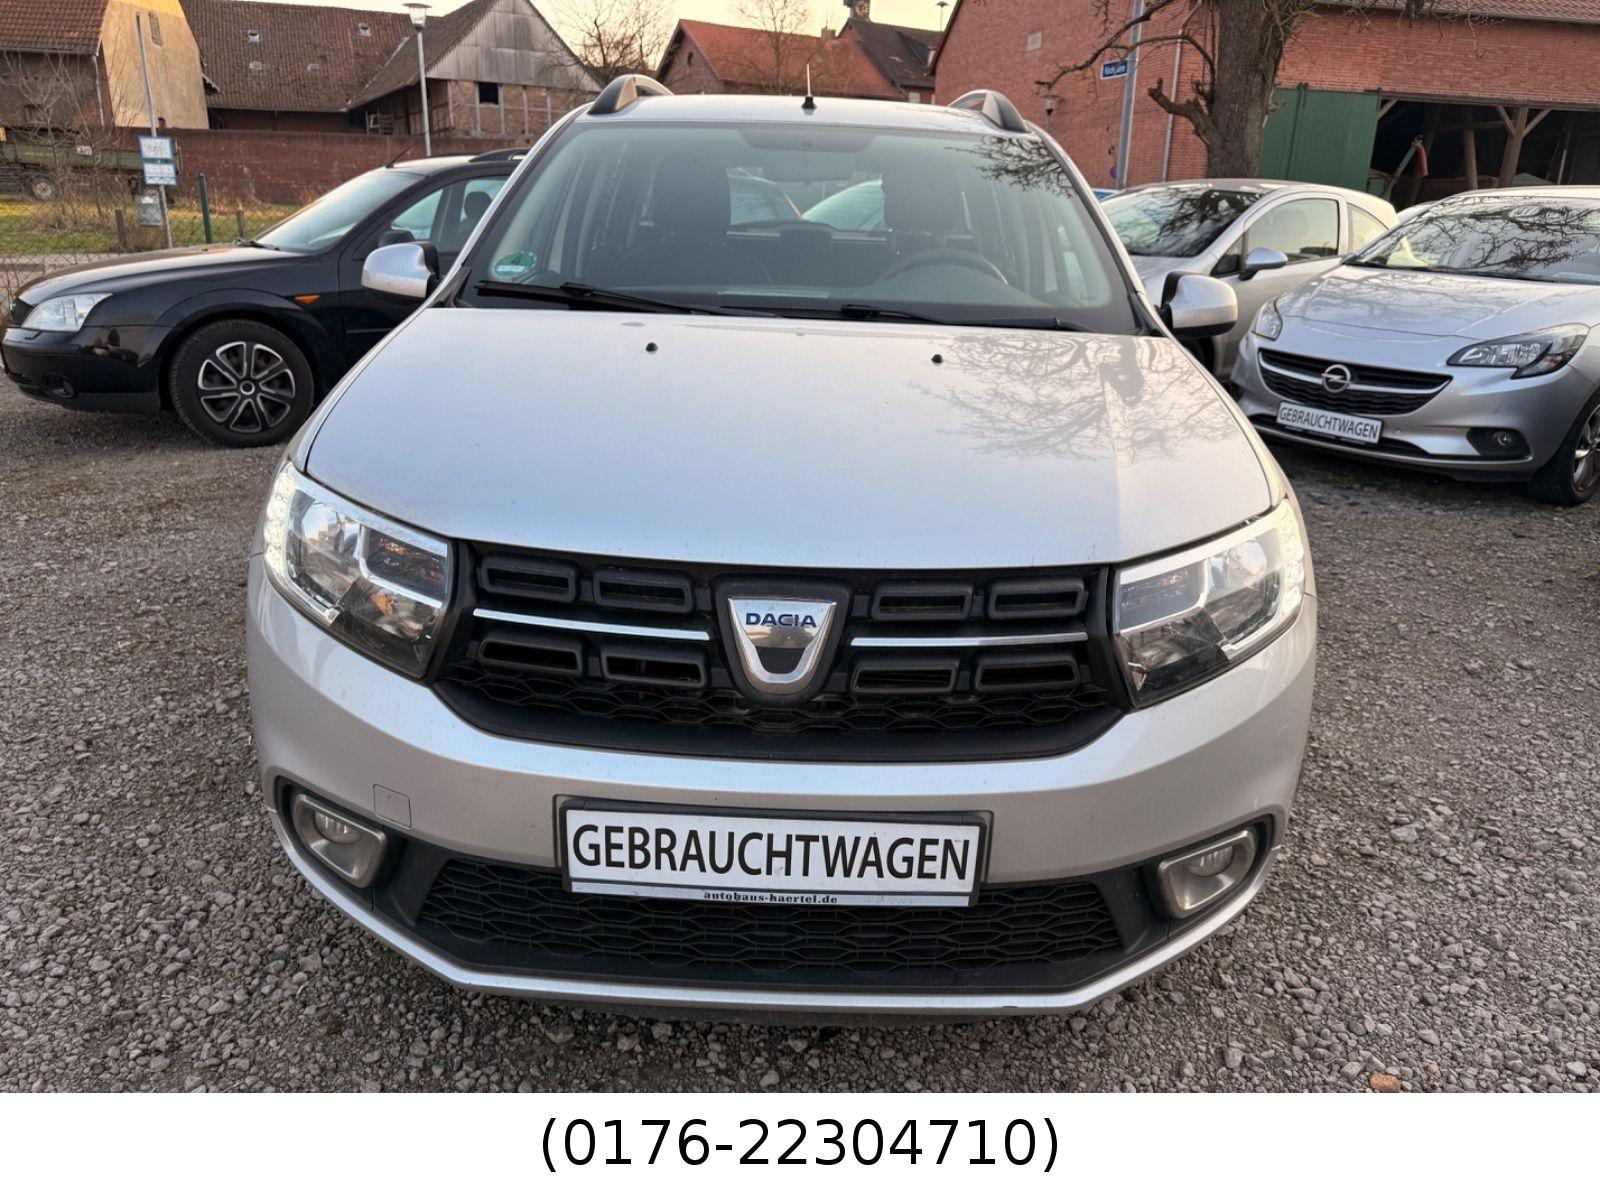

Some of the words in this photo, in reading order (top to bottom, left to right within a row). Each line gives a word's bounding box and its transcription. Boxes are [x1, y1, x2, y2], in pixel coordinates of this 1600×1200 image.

[1280, 407, 1379, 438] GEBRAUCHTWAGEN
[745, 613, 817, 628] DACIA
[572, 824, 970, 881] GEBRAUCHTWAGEN
[703, 892, 838, 904] autohaus-haertel.de
